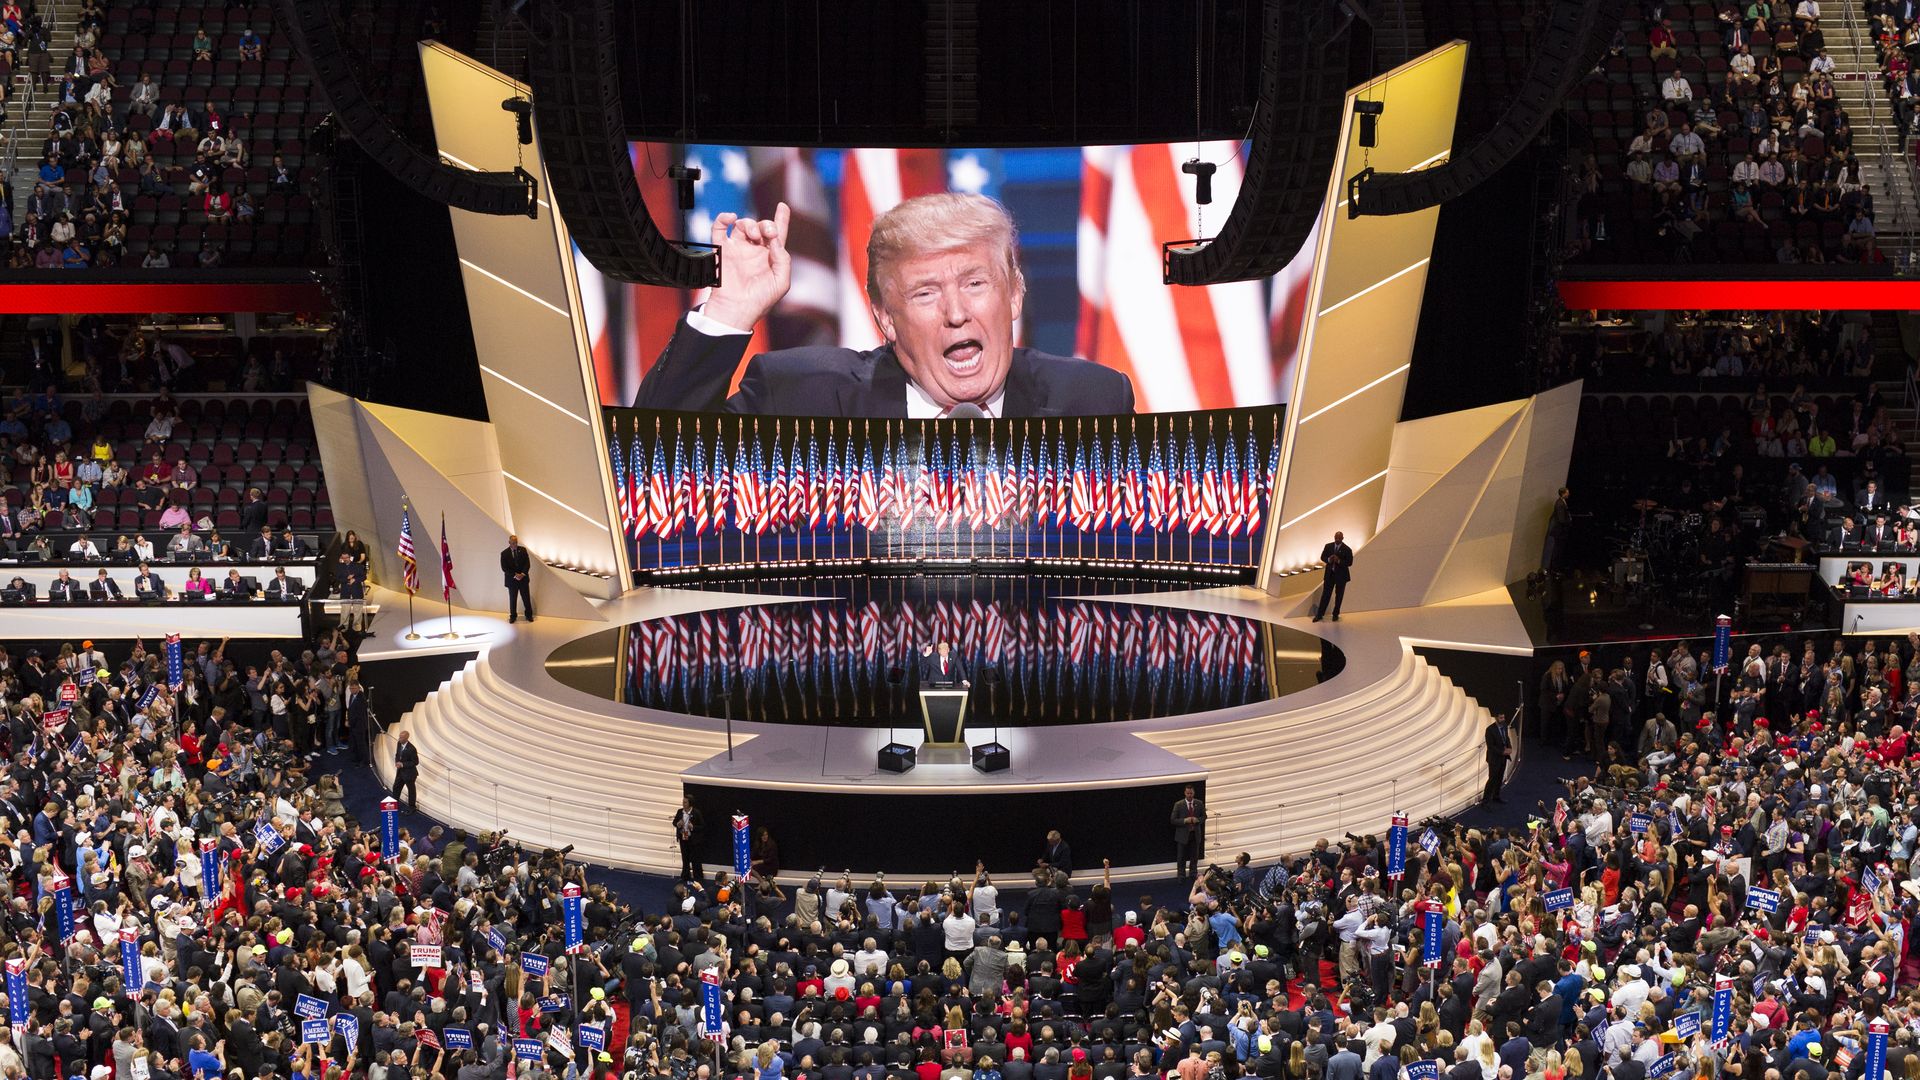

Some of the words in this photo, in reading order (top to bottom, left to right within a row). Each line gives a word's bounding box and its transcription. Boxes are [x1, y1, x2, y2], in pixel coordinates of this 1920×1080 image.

[386, 811, 394, 855] CONNECTICUT
[1394, 827, 1403, 869] CALIFORNIA
[1546, 892, 1572, 903] TRUMP
[1749, 890, 1778, 903] TRUMP
[61, 891, 69, 932] INDIANA
[523, 957, 547, 966] TRUMP
[10, 973, 19, 1018] ALASKA
[297, 1001, 325, 1015] AMERICA
[708, 985, 716, 1027] FLORIDA
[308, 1010, 322, 1018] AGAIN
[1717, 993, 1727, 1034] NEVADA
[303, 1027, 329, 1035] AMERICA
[1677, 1018, 1700, 1031] AMERICA
[581, 1030, 603, 1039] TRUMP
[1409, 1064, 1437, 1073] TRUMP
[1651, 1057, 1673, 1073] TRUMP
